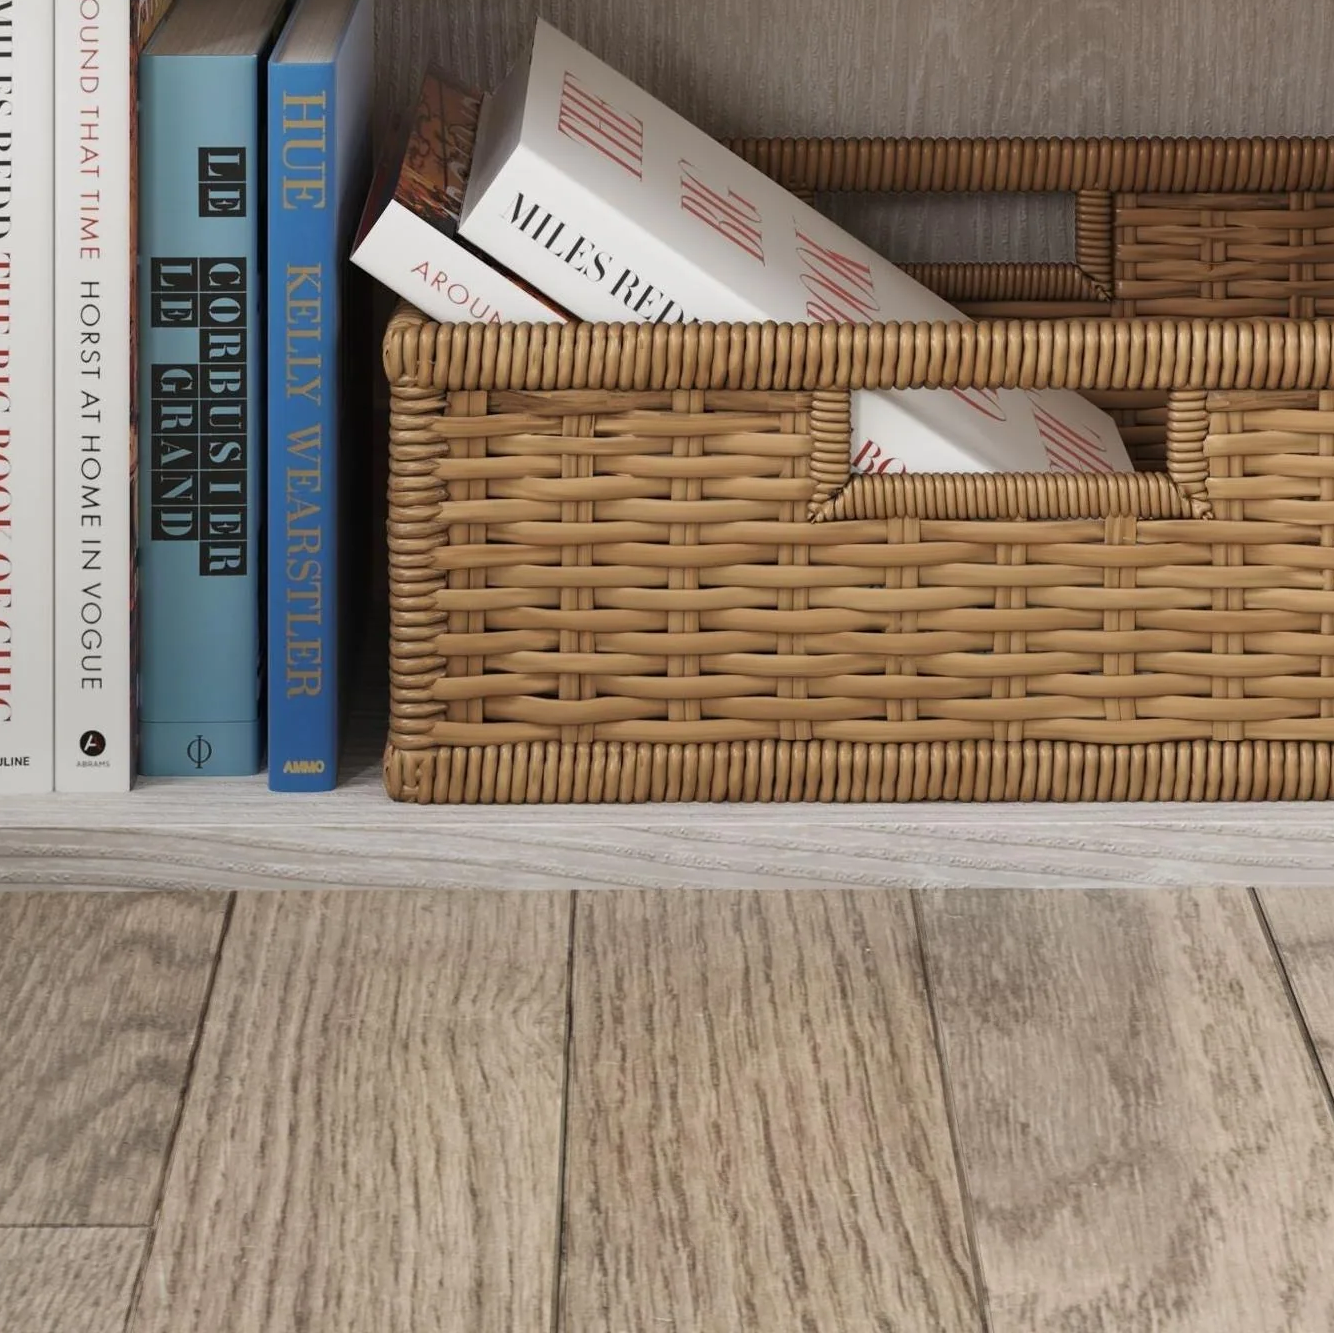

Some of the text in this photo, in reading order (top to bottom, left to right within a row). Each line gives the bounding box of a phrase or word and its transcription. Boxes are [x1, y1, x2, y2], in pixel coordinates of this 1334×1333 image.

[79, 105, 101, 179] THAT
[557, 70, 644, 182] THE
[677, 157, 765, 267] BIG
[79, 190, 101, 260] TIME
[499, 192, 613, 282] MILES
[608, 268, 701, 322] RED
[80, 281, 101, 380] HORST
[206, 152, 242, 572] LE CORBUSIER
[80, 391, 102, 424] AT
[160, 263, 194, 536] LE GRAND
[282, 90, 327, 699] HUE KELLY WEARSTLER
[80, 436, 102, 528] HOME
[81, 540, 102, 571] IN
[81, 582, 103, 690] VOGUE
[76, 760, 110, 768] ABRAMS
[283, 760, 325, 774] AMMO
